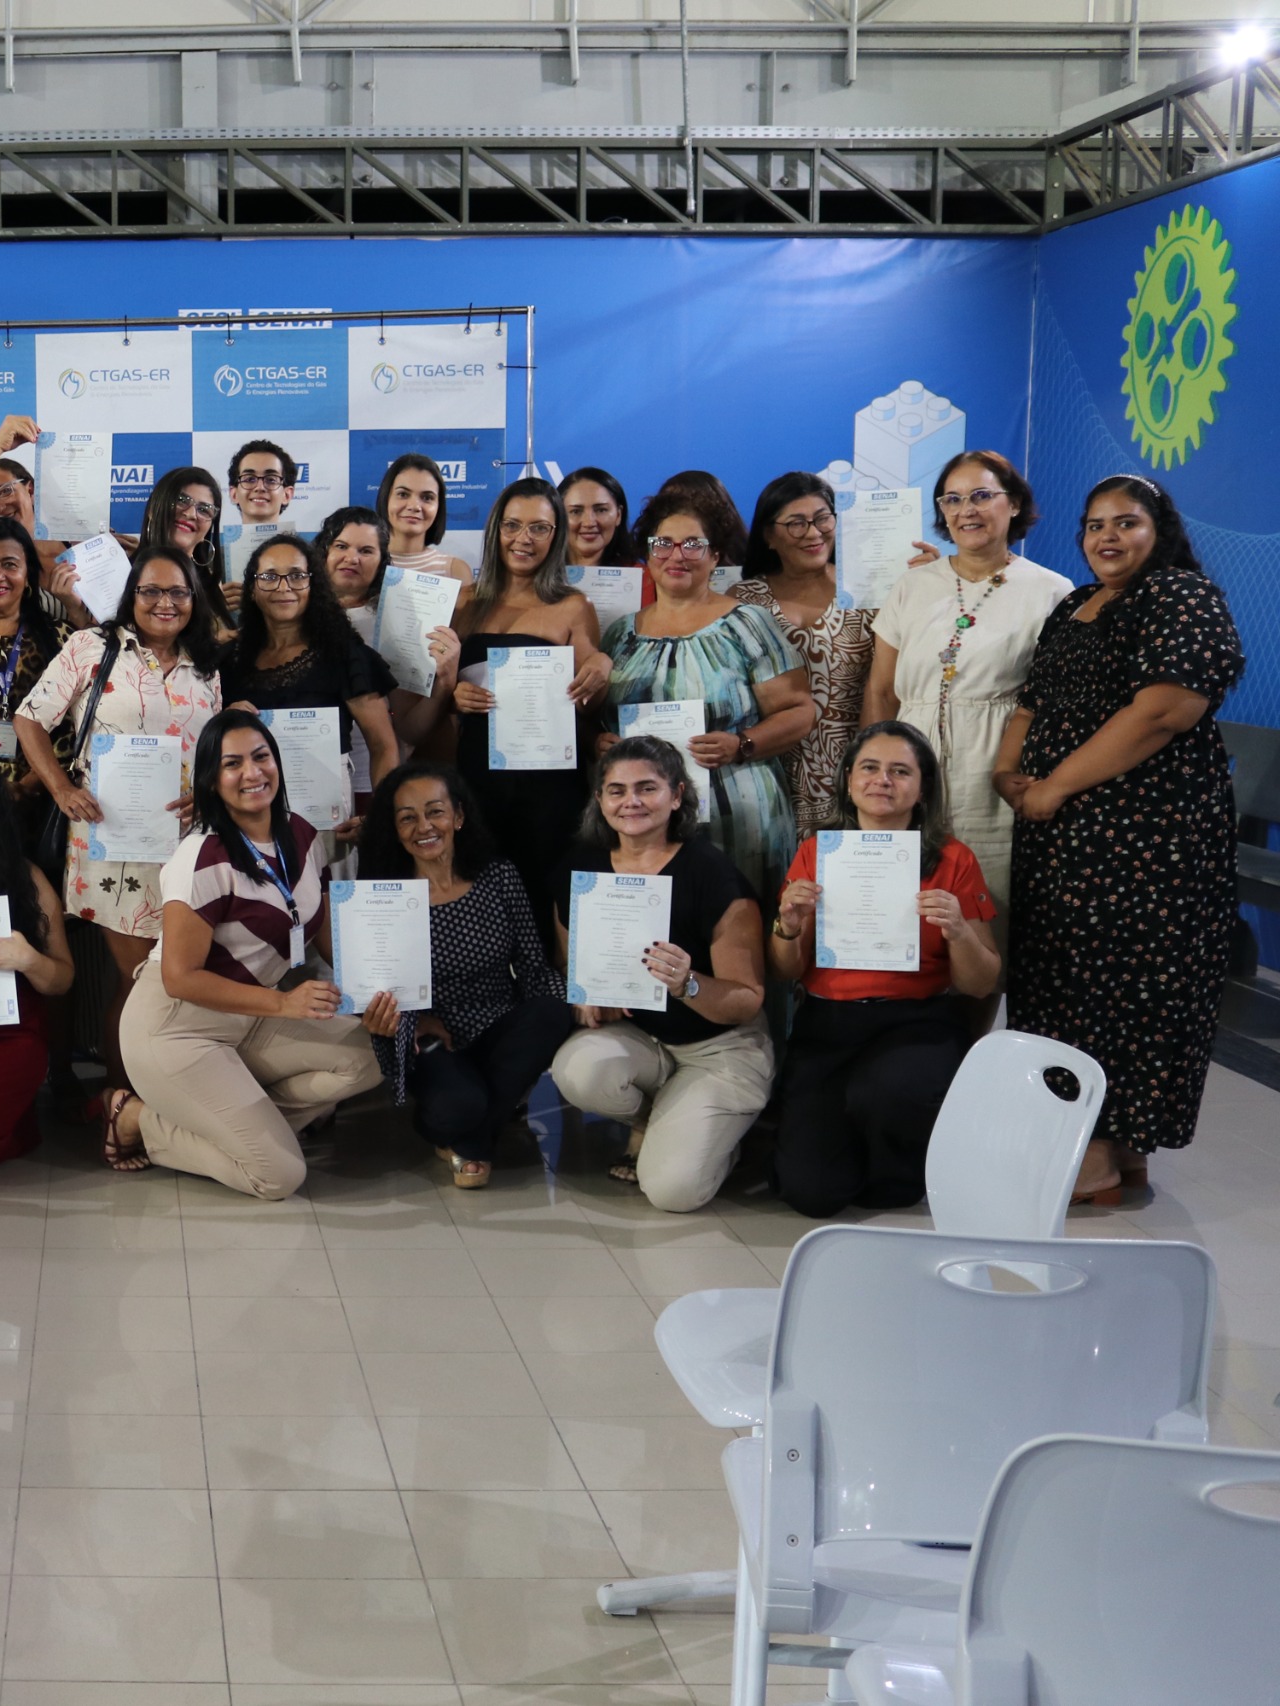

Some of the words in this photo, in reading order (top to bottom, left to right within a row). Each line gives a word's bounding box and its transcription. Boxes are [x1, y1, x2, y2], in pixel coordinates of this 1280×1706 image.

[89, 368, 170, 382] CTGAS-ER
[245, 366, 327, 380] CTGAS-ER
[402, 364, 484, 377] CTGAS-ER
[110, 468, 148, 483] NAI
[373, 883, 402, 891] SENAI
[616, 877, 645, 886] SENAI
